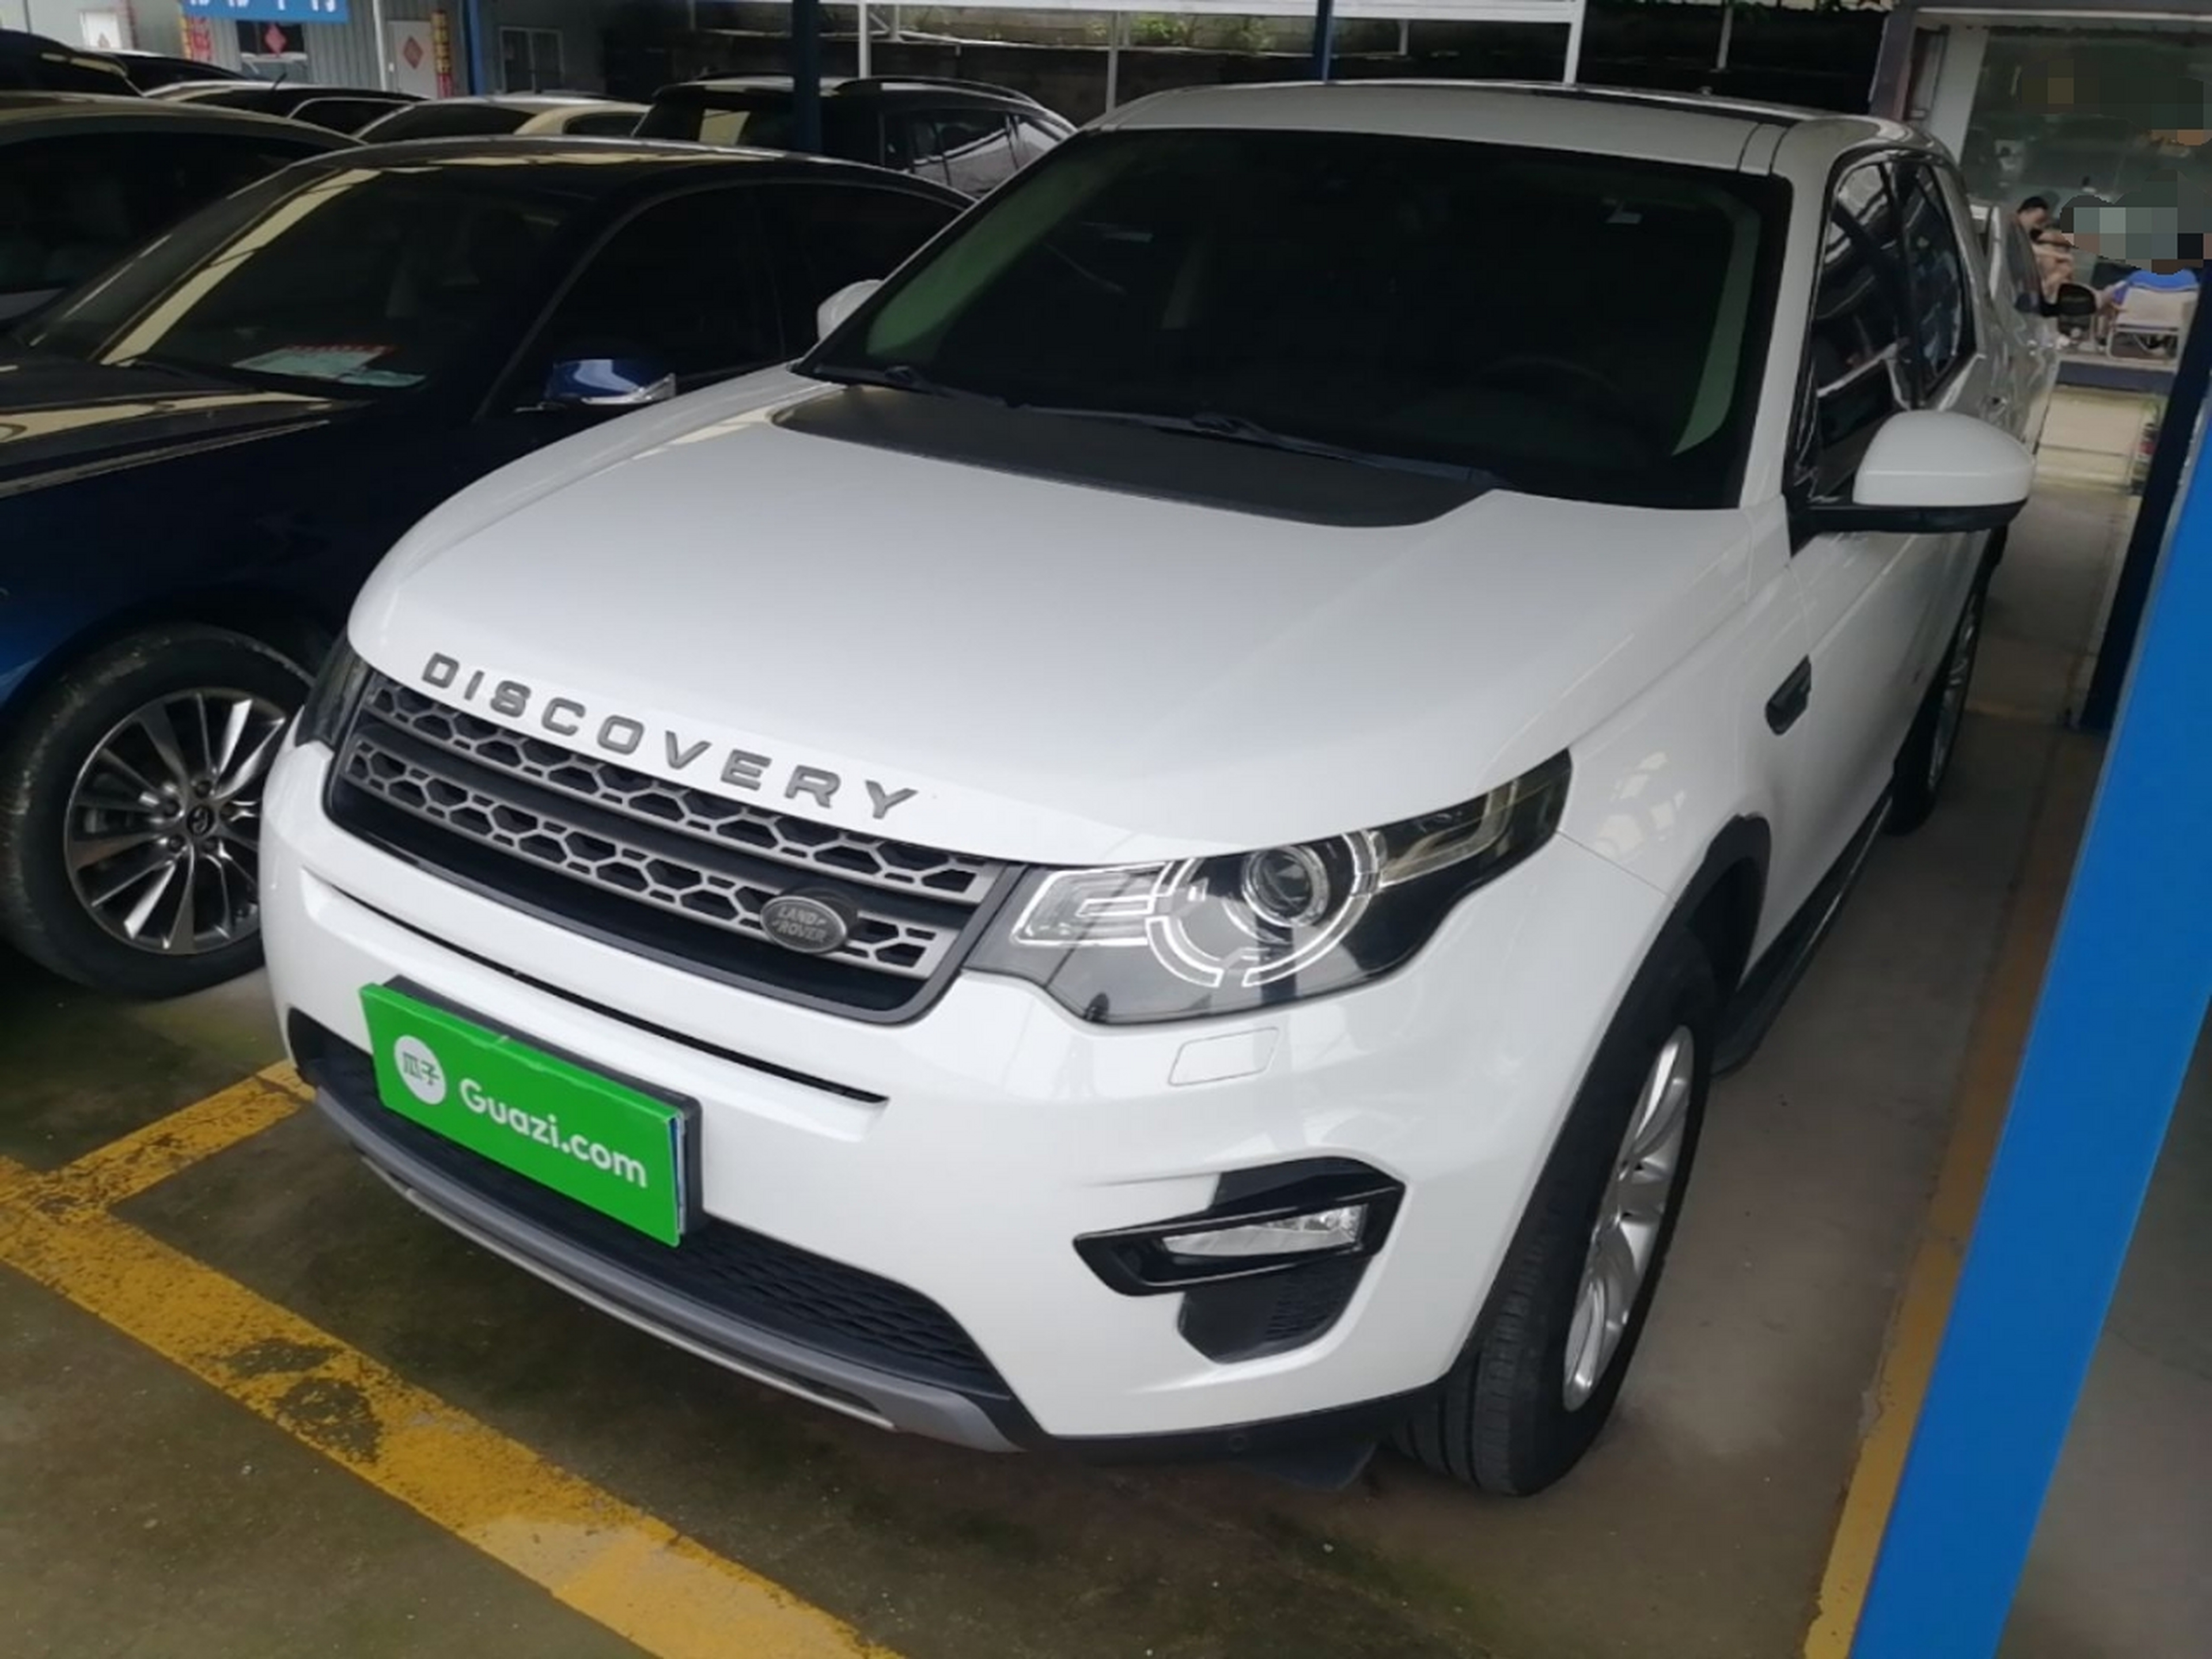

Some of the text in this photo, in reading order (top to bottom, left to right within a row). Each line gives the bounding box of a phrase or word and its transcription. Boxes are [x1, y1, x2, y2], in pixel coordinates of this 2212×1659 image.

[422, 653, 917, 819] DISCOVERY
[777, 921, 827, 942] ROVER
[778, 906, 818, 925] LAND
[460, 1078, 648, 1188] Guazi.com
